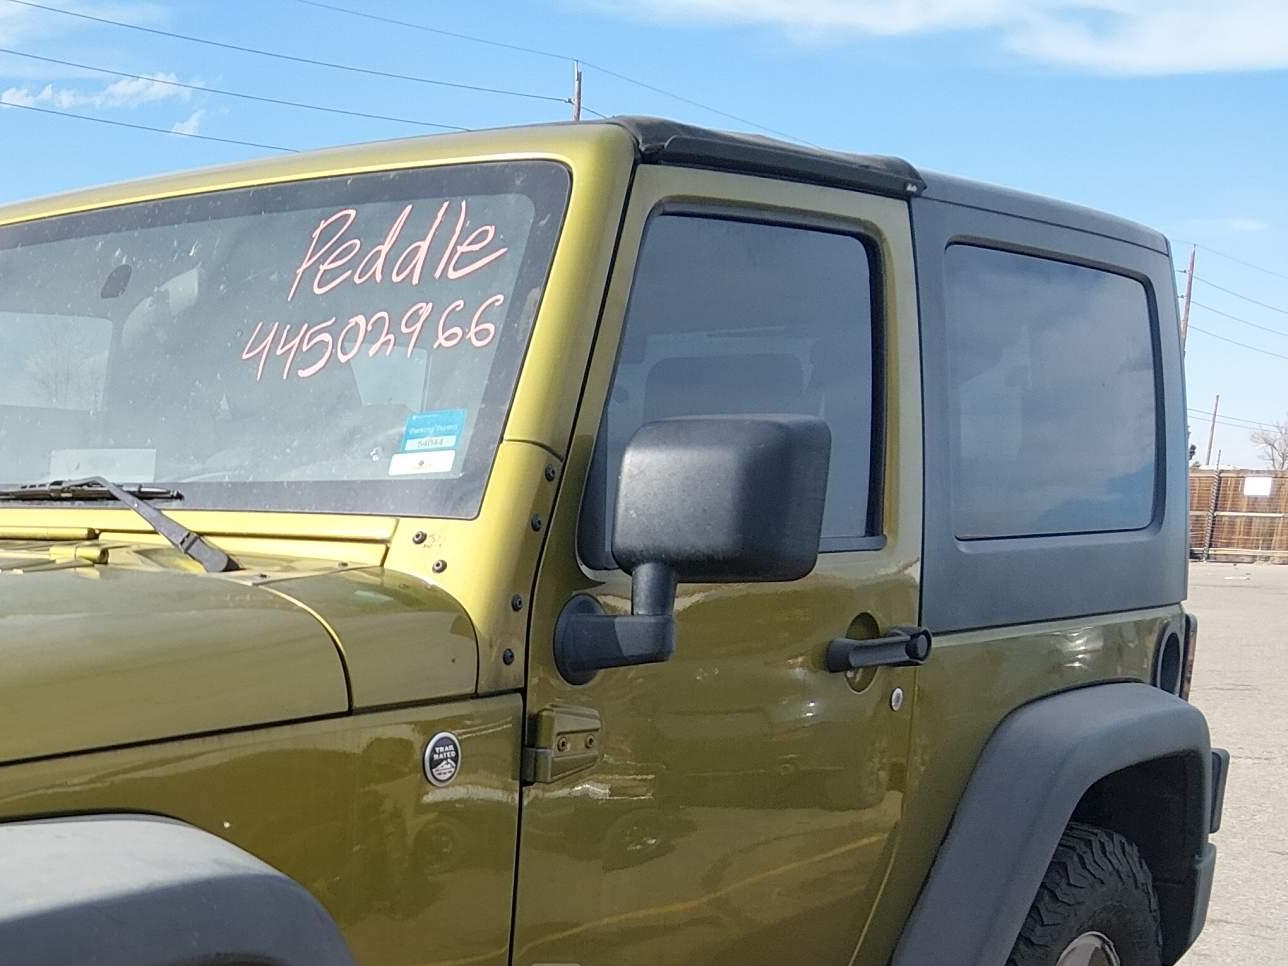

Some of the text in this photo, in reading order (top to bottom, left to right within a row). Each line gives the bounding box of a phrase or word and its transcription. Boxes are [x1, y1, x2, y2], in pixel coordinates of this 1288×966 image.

[288, 200, 508, 302] Peddle
[241, 294, 506, 382] 44502966
[433, 751, 456, 760] RATED
